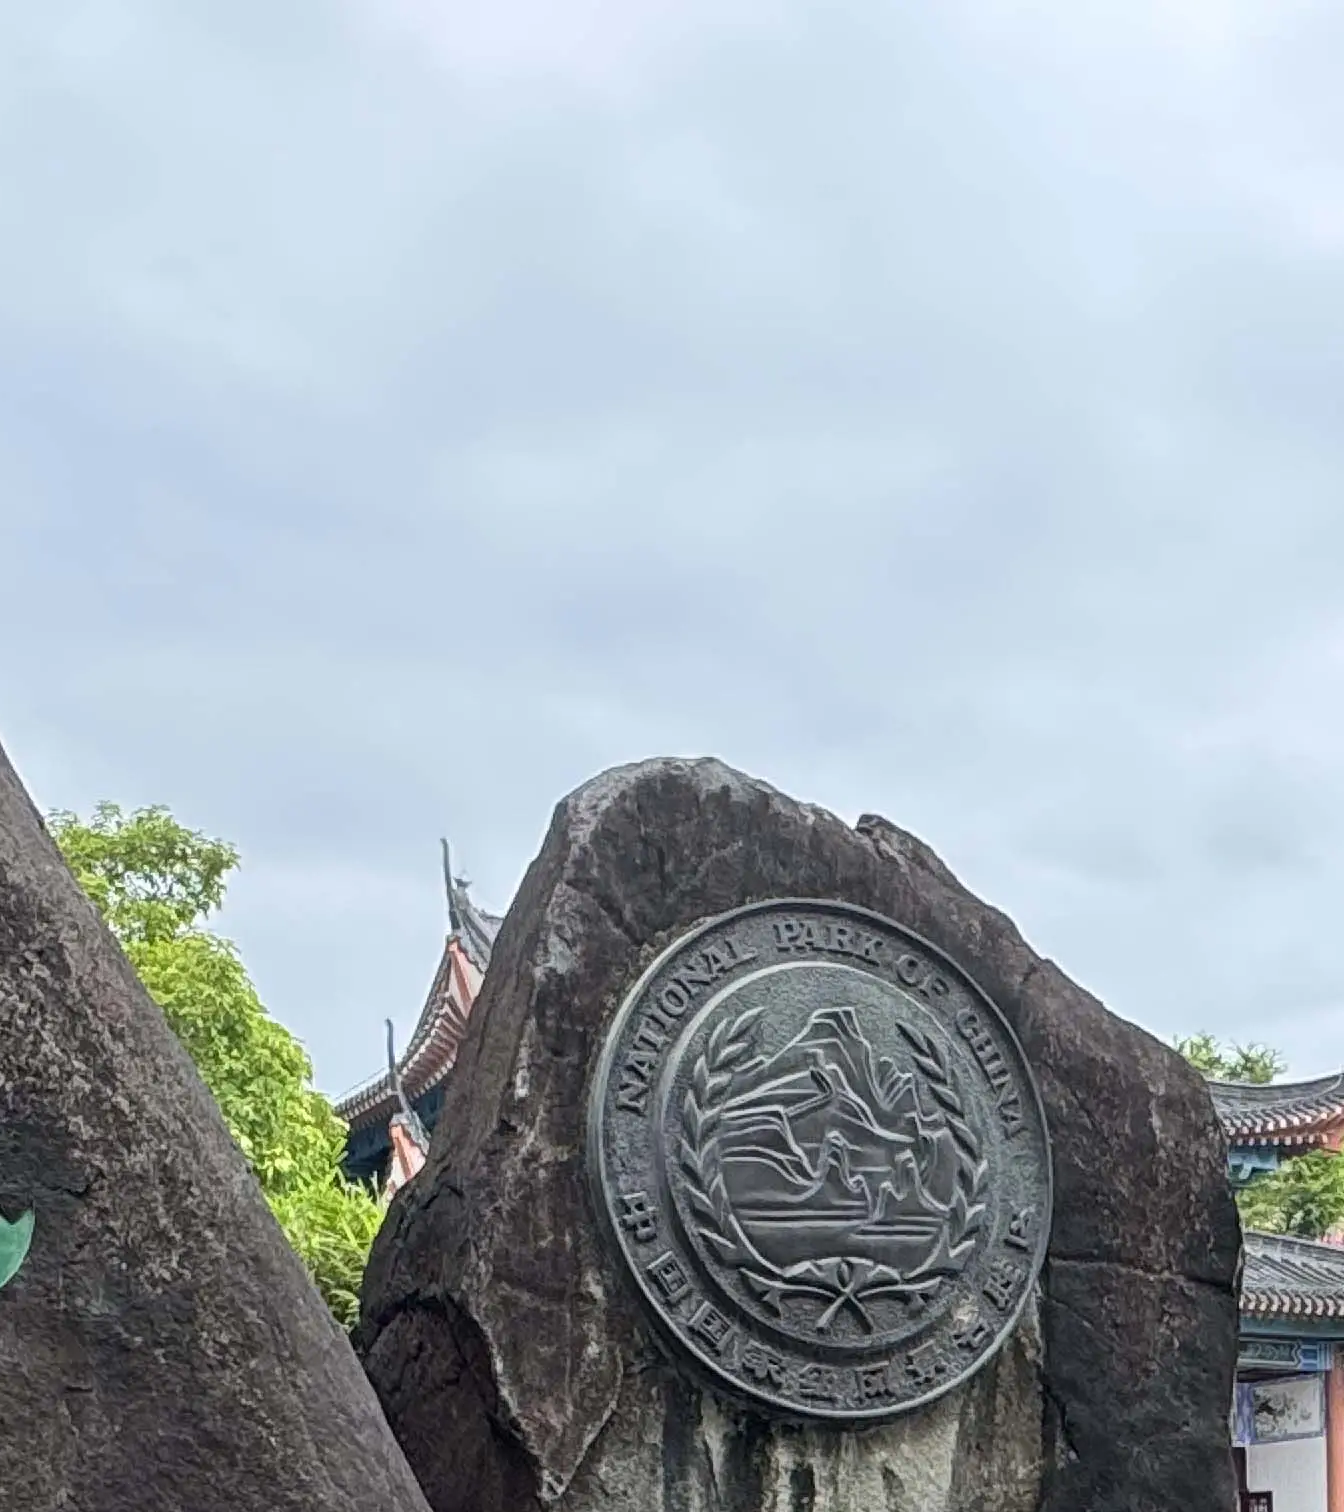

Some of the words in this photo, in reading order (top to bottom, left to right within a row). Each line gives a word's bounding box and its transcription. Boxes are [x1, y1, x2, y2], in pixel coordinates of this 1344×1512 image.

[617, 938, 757, 1117] NATIONAL
[771, 918, 881, 968] PARK
[894, 951, 949, 1001] OF
[954, 1006, 1027, 1140] CHINA
